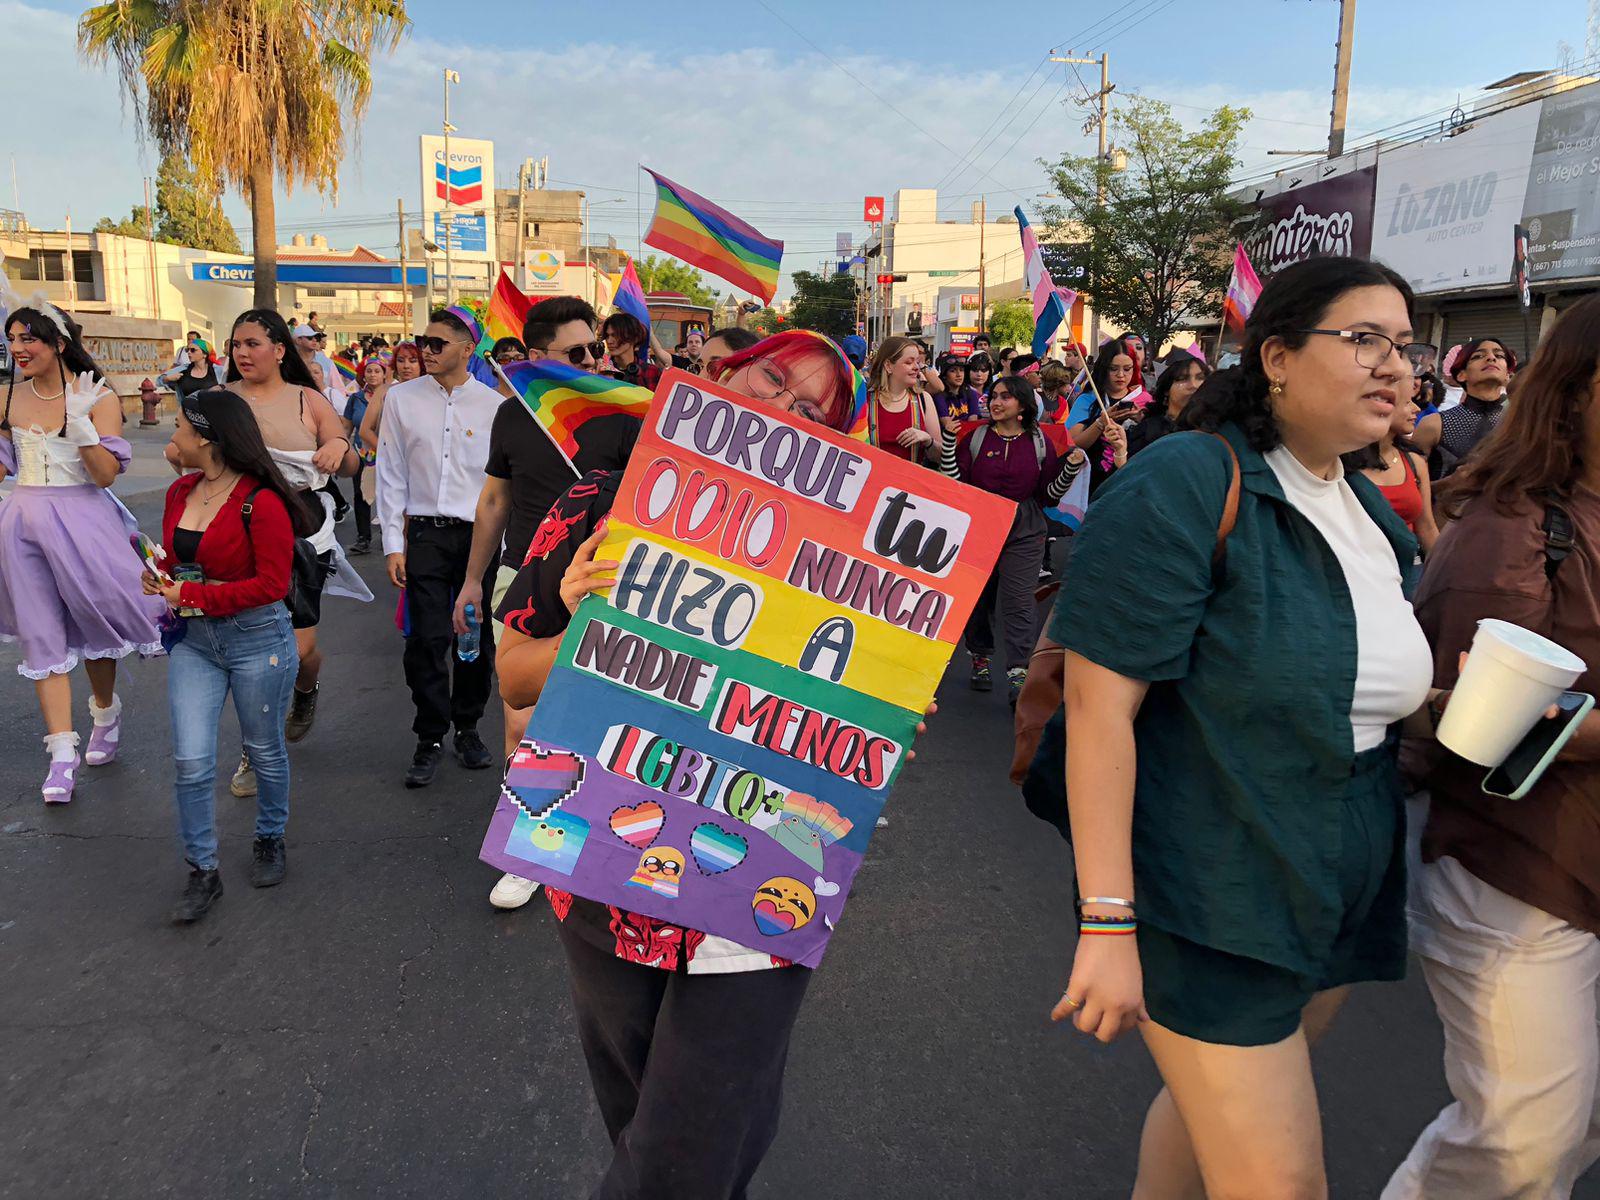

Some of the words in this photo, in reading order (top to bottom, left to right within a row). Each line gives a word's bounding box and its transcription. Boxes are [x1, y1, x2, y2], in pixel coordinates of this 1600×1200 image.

[1387, 171, 1498, 237] LOZANO
[1549, 161, 1588, 184] Mejor
[1589, 156, 1600, 175] S
[209, 265, 254, 280] Chevr
[1425, 229, 1449, 243] AUTO
[1450, 221, 1484, 238] CENTER
[662, 383, 863, 511] PORQUE
[875, 490, 960, 573] tu
[635, 457, 789, 569] ODIO
[789, 540, 948, 639] NUNCA
[615, 543, 757, 647] HIZO
[799, 616, 855, 683] A
[578, 619, 711, 709] NADIE
[715, 681, 897, 790] MENOS
[607, 724, 786, 823] LGBTQ+
